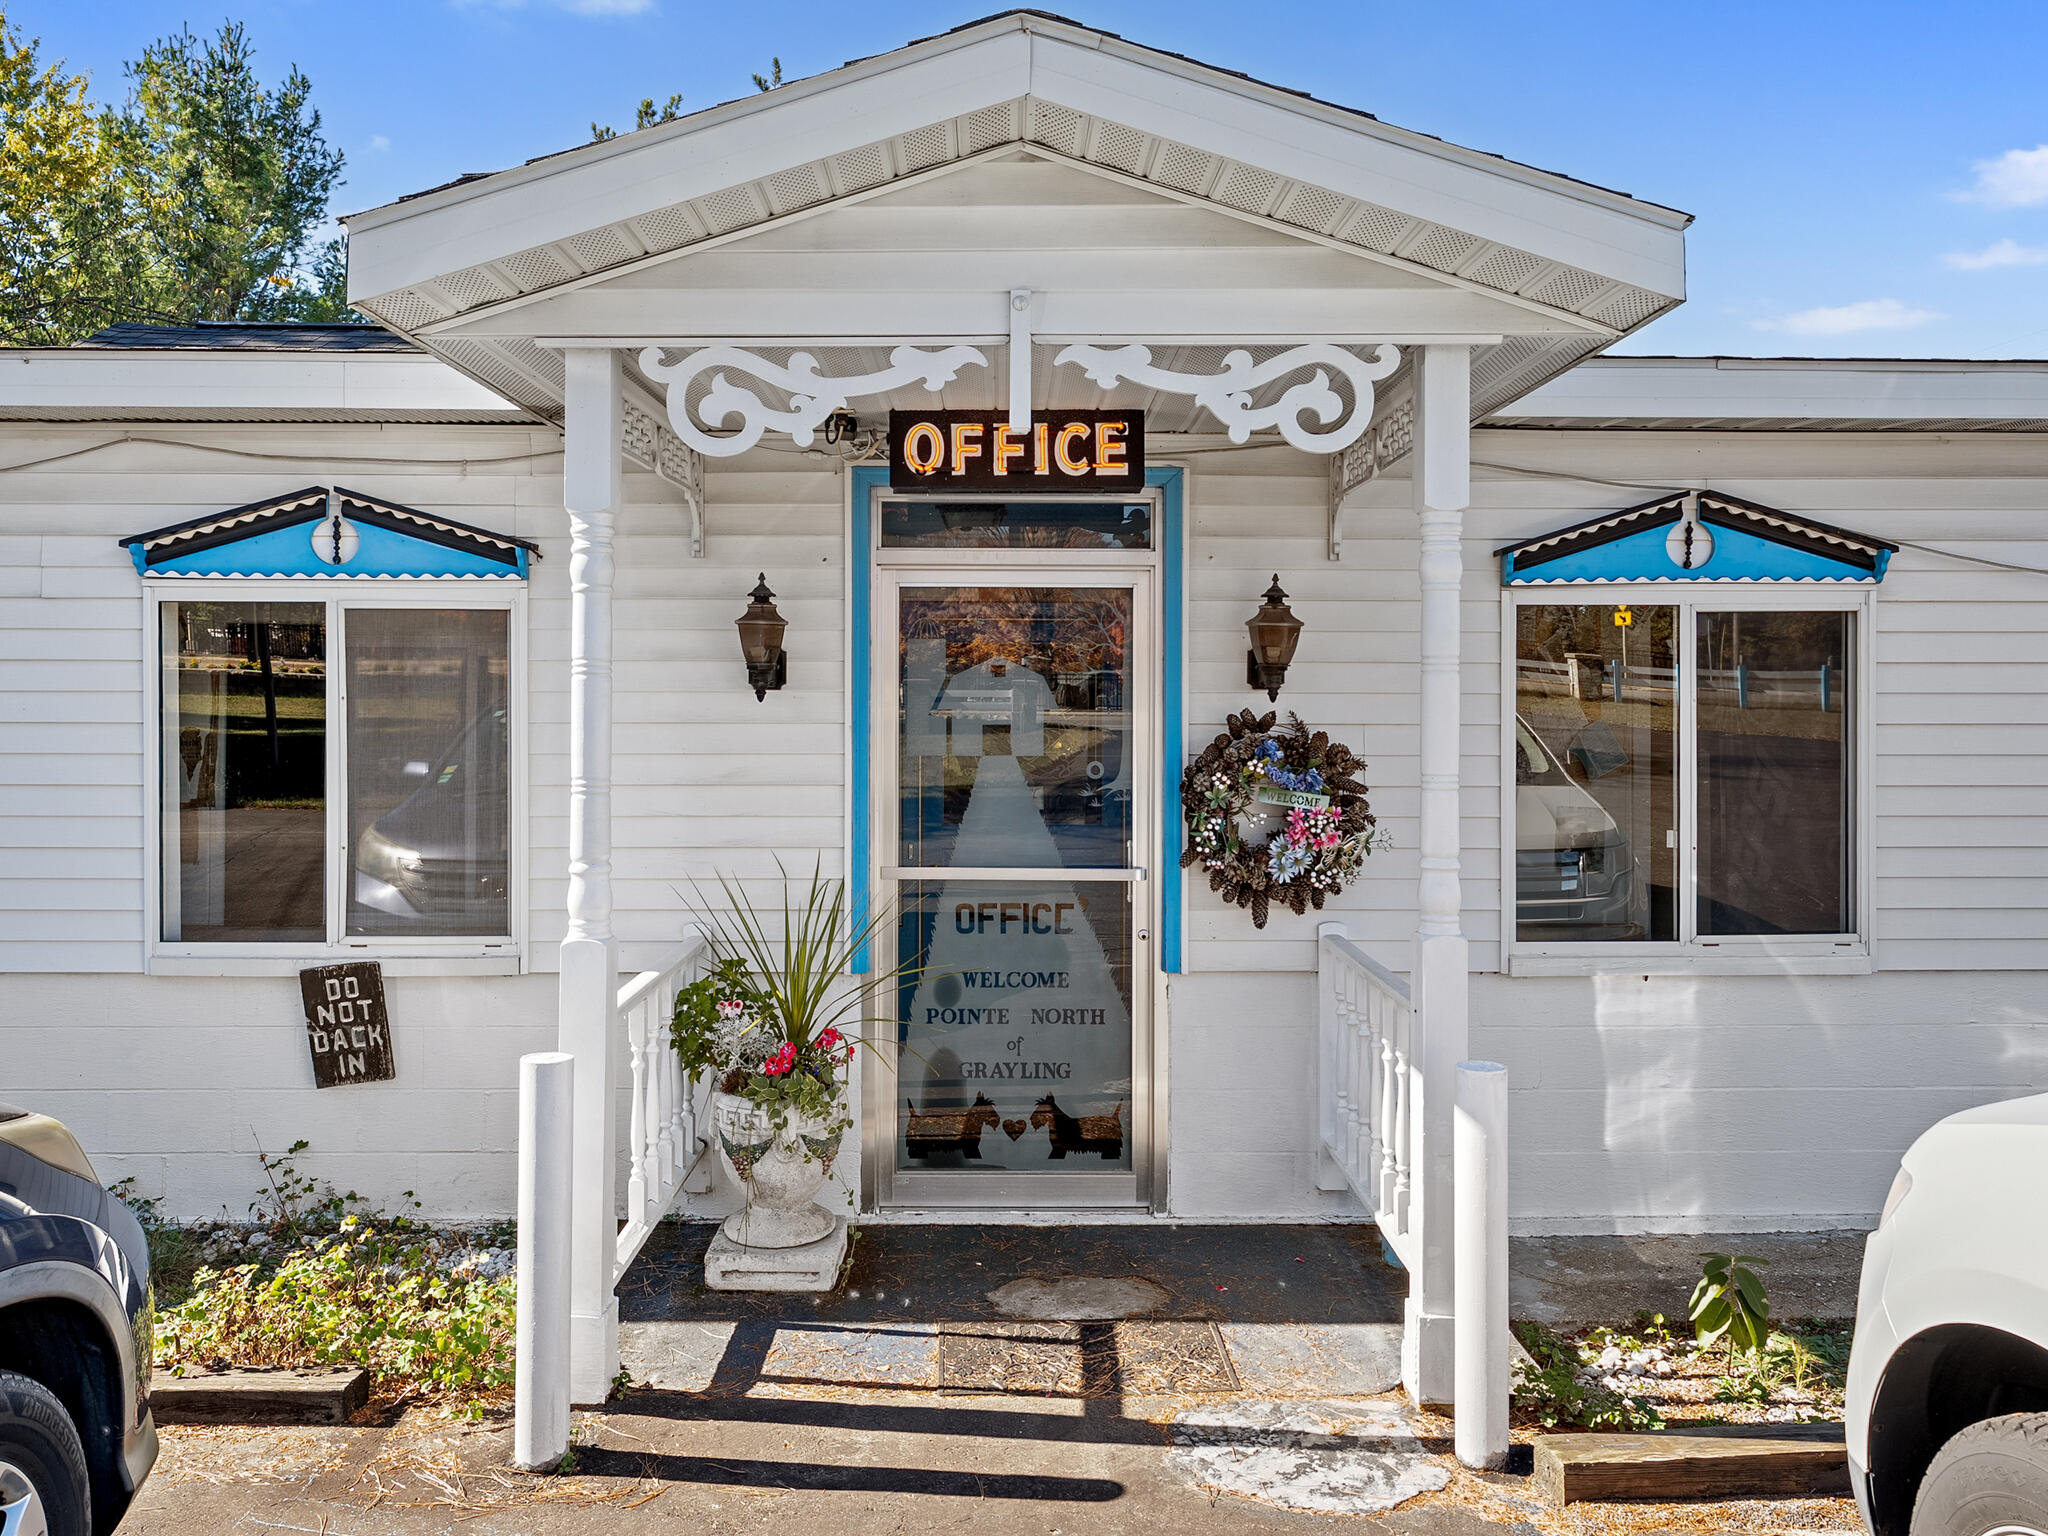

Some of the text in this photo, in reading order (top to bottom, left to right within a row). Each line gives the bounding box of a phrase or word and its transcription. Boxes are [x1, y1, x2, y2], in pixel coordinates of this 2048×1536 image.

[904, 422, 1129, 476] OFFICE
[1267, 791, 1321, 807] WELCOME
[955, 903, 1075, 935] OFFICE
[325, 976, 360, 1000] DO
[962, 971, 1070, 989] WELCOME
[316, 999, 373, 1026] NOT
[926, 1008, 1106, 1025] POINTE NORTH
[1006, 1036, 1025, 1056] of
[339, 1052, 366, 1078] IN
[960, 1062, 1071, 1080] GRAYLING
[21, 1397, 85, 1477] BRIDGESTONE
